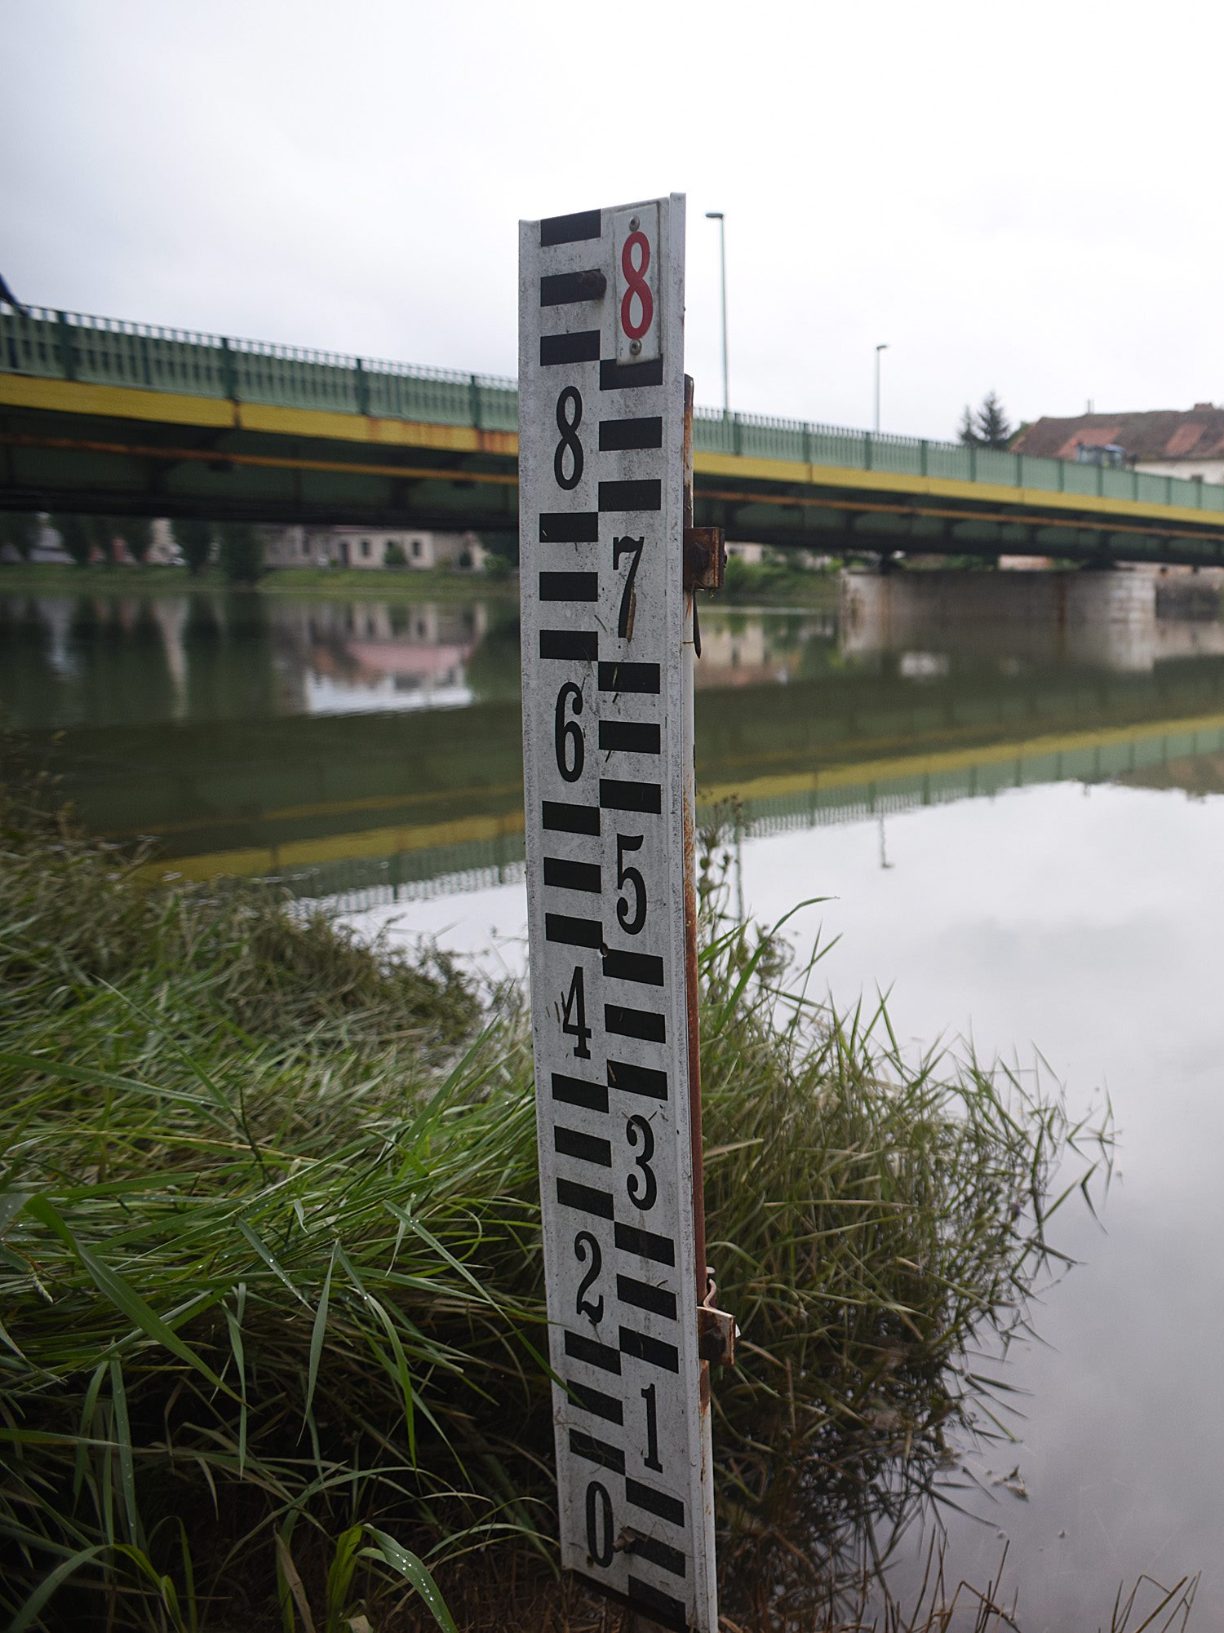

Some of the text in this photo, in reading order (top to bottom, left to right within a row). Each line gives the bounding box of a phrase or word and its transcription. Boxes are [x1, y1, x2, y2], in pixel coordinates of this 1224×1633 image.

[621, 231, 653, 340] 8
[554, 386, 584, 490] 8
[613, 536, 645, 639] 7
[555, 682, 584, 783] 6
[616, 833, 647, 935] 5
[562, 966, 592, 1060] 4
[626, 1114, 658, 1211] 3
[574, 1230, 604, 1323] 2
[641, 1383, 664, 1474] 1
[586, 1480, 615, 1569] 0
